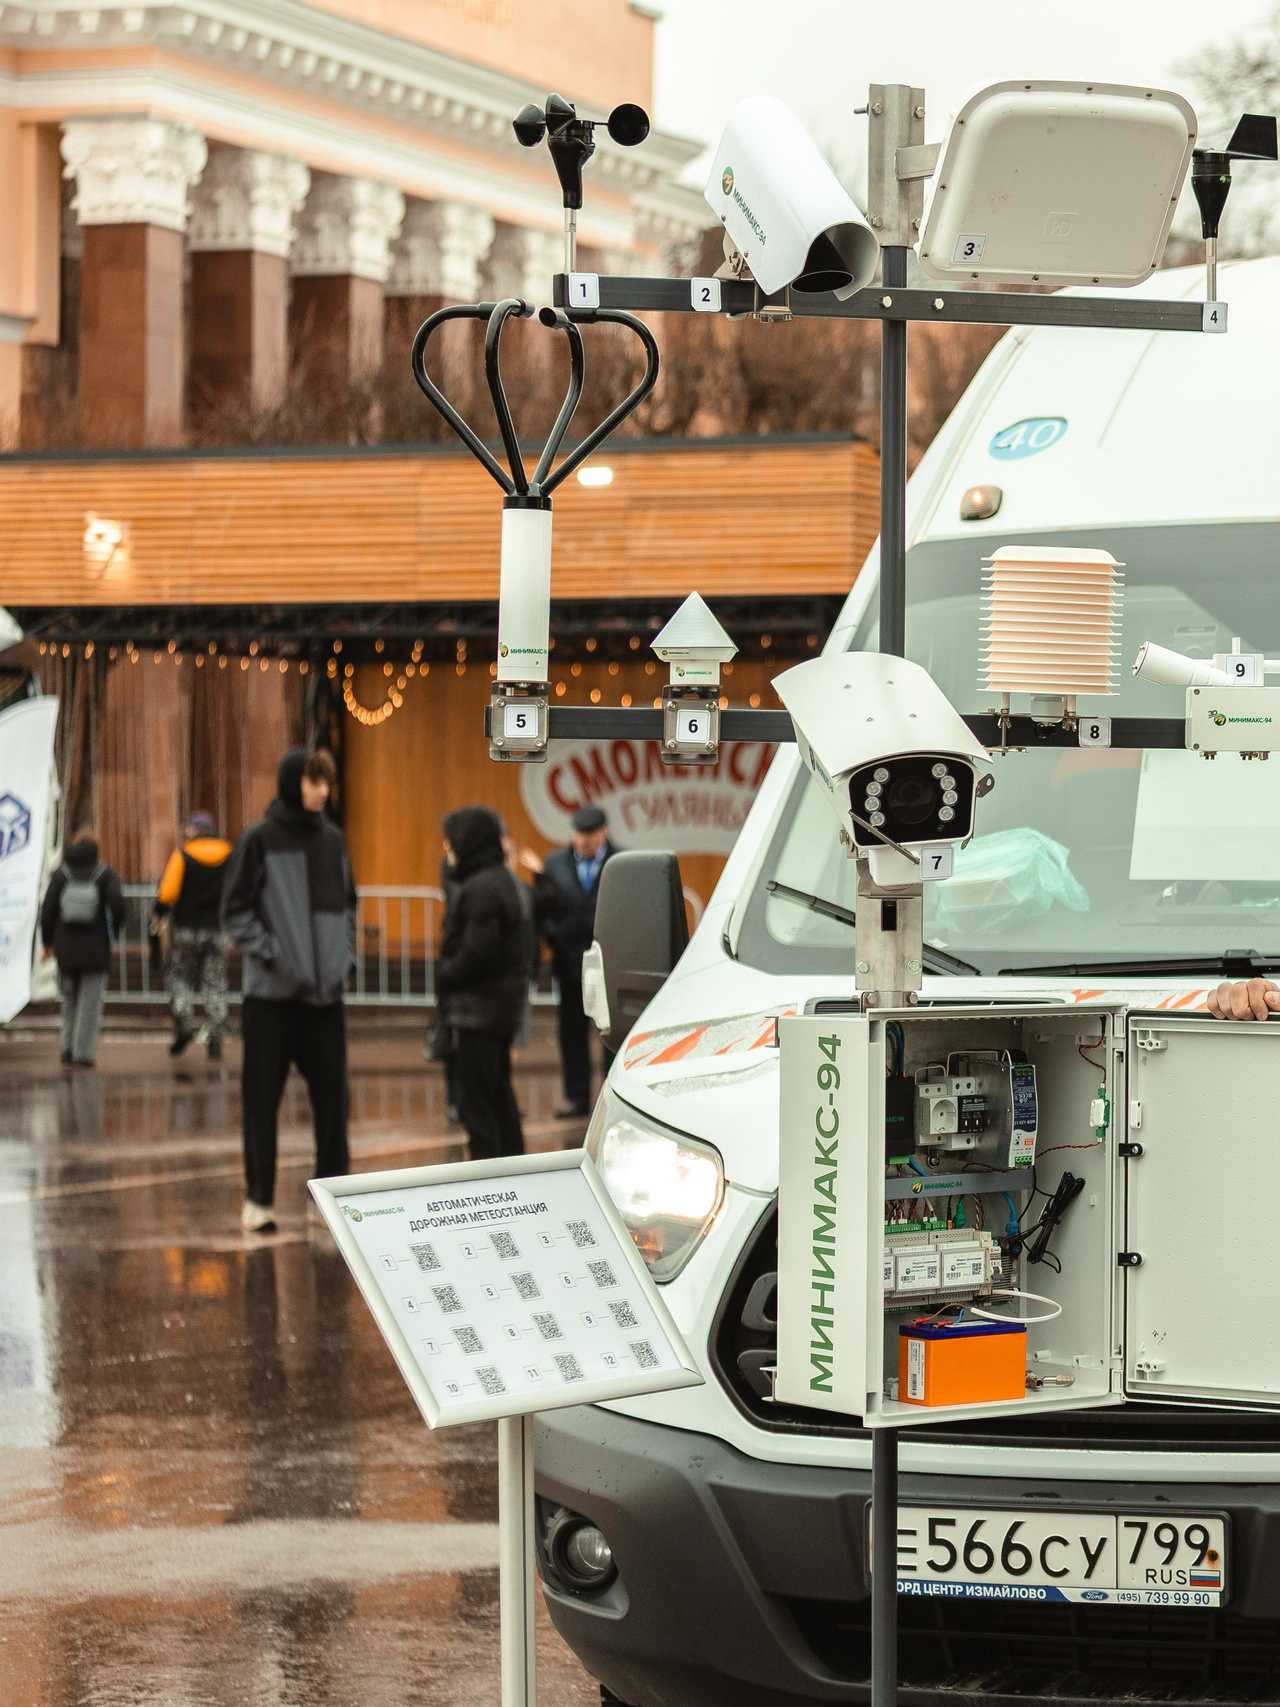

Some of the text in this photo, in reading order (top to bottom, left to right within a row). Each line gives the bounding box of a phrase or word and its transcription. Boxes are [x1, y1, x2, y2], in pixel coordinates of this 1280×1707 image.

[733, 187, 767, 246] МИНИМАКС-94
[963, 242, 975, 256] 3
[579, 283, 587, 298] 1
[701, 287, 711, 303] 2
[1210, 310, 1219, 324] 4
[996, 421, 1062, 452] 40
[1235, 663, 1246, 678] 9
[516, 713, 527, 729] 5
[688, 719, 699, 734] 6
[1089, 724, 1100, 740] 8
[931, 855, 943, 870] 7
[924, 1181, 963, 1190] МИНИМАКС-94
[427, 1190, 519, 1213] АВТОМАТИЧЕСКАЯ
[363, 1206, 405, 1218] МИНИМАКС-94
[409, 1202, 549, 1233] ДОРОЖНАЯ МЕТЕОСТАНЦИЯ
[810, 1033, 842, 1393] МИНИМАКС-94
[541, 1235, 550, 1244] 3
[464, 1246, 473, 1256] 2
[385, 1259, 391, 1268] 1
[563, 1275, 571, 1285] 6
[486, 1287, 494, 1297] 5
[407, 1300, 415, 1310] 4
[585, 1315, 593, 1324] 9
[508, 1328, 516, 1337] 8
[427, 1341, 434, 1351] 7
[603, 1355, 616, 1365] 12
[527, 1368, 539, 1378] 11
[447, 1383, 458, 1393] 10
[1123, 1520, 1210, 1567] 799
[1145, 1568, 1188, 1586] RUS
[897, 1581, 1047, 1599] ОРД ЦЕНТР ИЗМАЙЛОВО
[1116, 1593, 1141, 1603] (495)
